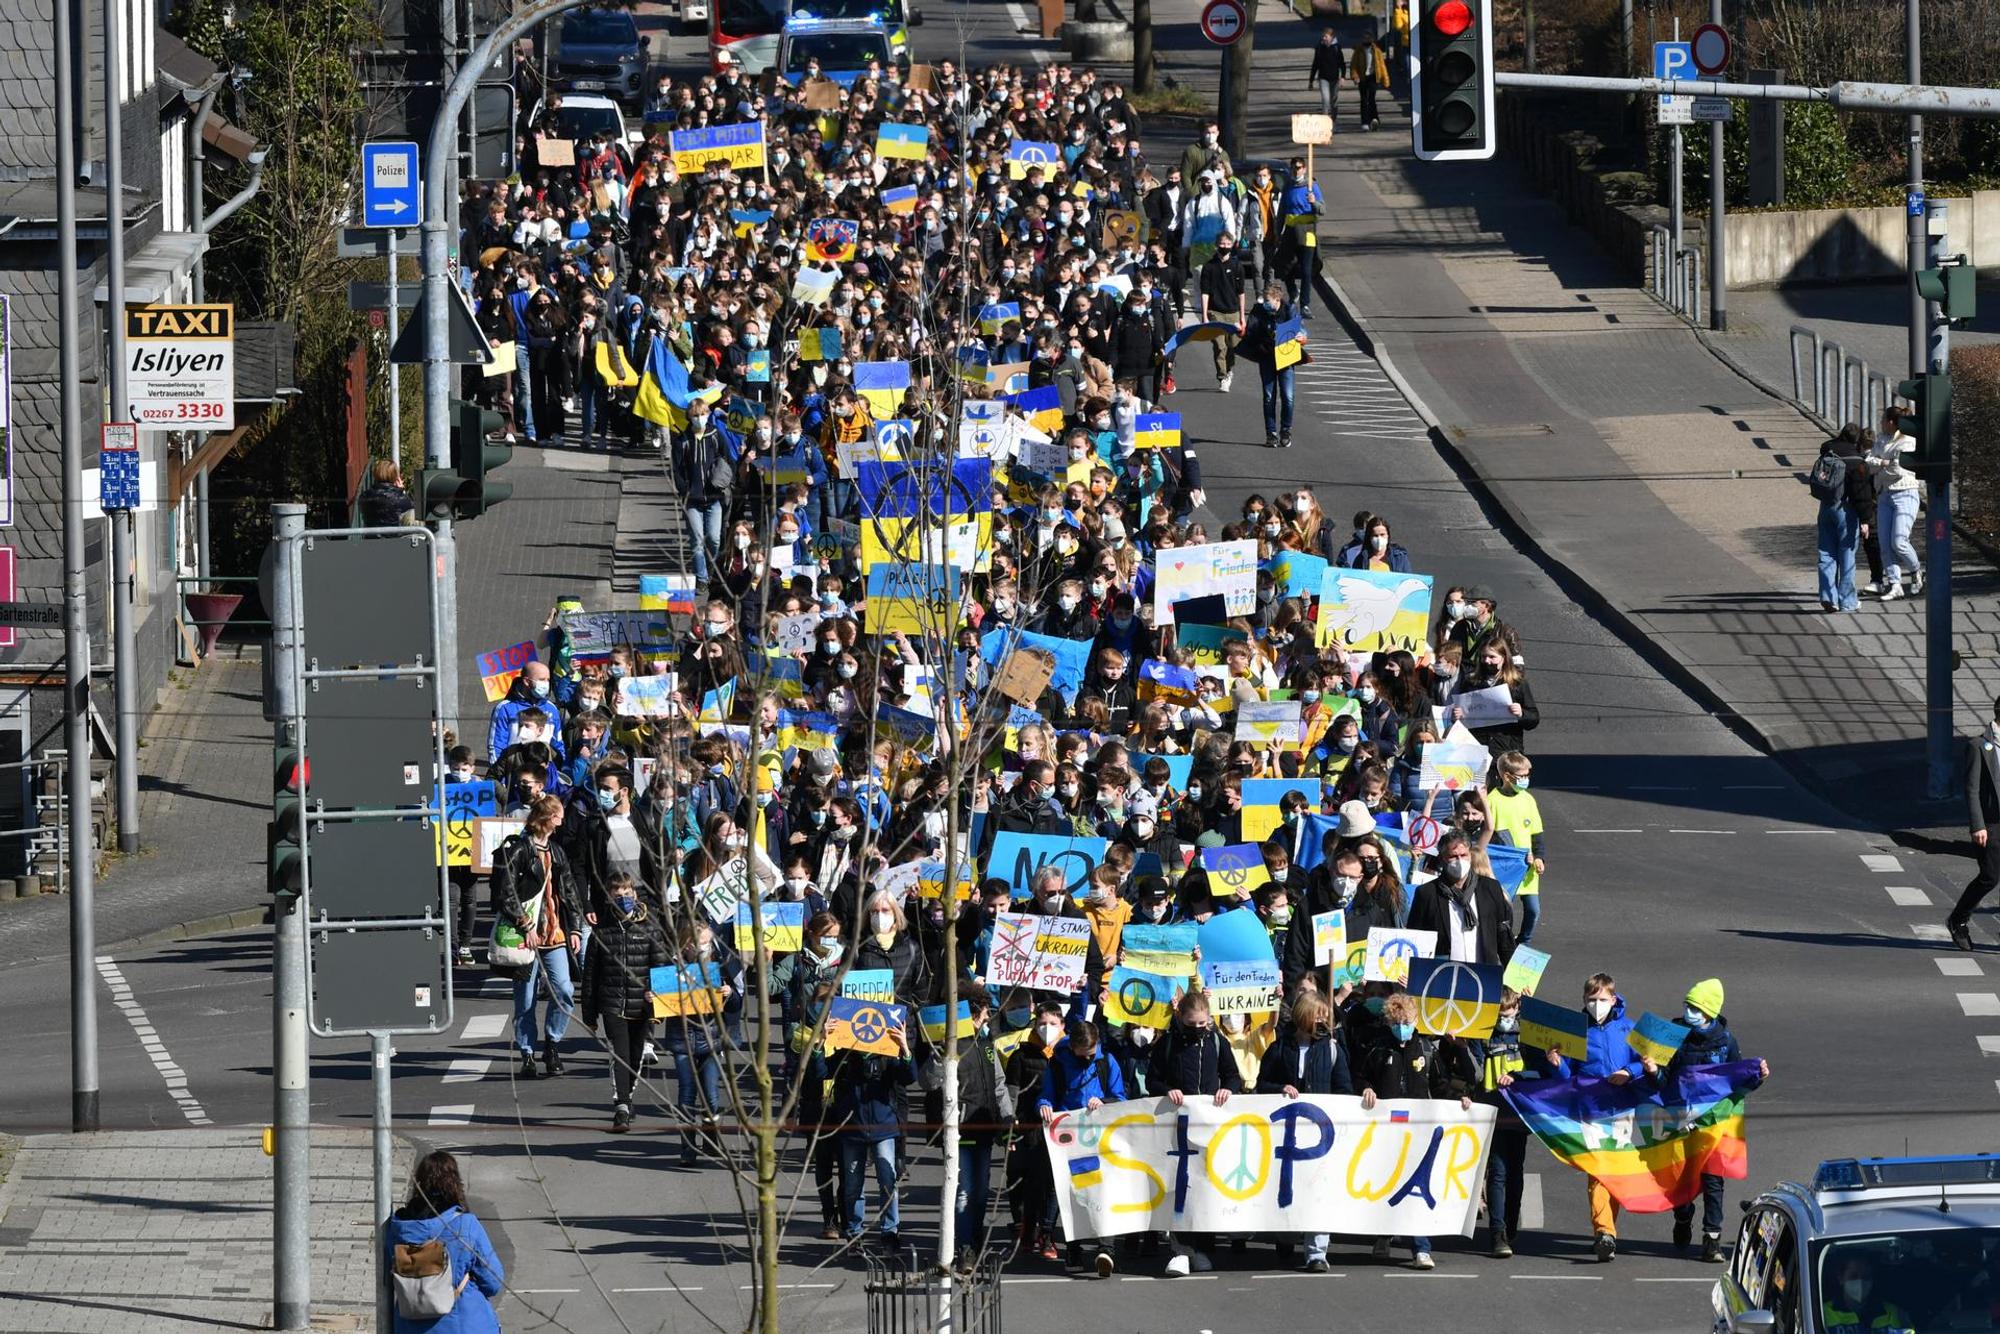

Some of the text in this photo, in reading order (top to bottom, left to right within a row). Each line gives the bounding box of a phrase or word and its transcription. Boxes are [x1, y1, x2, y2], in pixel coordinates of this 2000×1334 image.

[1664, 48, 1687, 80] P
[678, 150, 716, 170] STOP
[377, 165, 406, 176] Polizei
[134, 312, 220, 334] TAXI
[131, 347, 225, 377] Isliyen
[147, 389, 206, 397] Vertrauenssache
[143, 403, 224, 418] 02267 3330
[484, 642, 536, 674] STOP
[438, 841, 472, 857] WA
[1013, 846, 1096, 895] NO
[1043, 916, 1060, 927] WE
[1060, 922, 1092, 934] STAND
[1035, 938, 1089, 958] UKRAINE
[993, 956, 1032, 972] STOP
[1043, 974, 1073, 988] STOP
[1214, 971, 1233, 985] Für
[1234, 971, 1252, 983] den
[844, 981, 895, 1002] FRIEDEN
[1218, 993, 1276, 1011] UKRAINE
[1346, 1119, 1481, 1211] WAR
